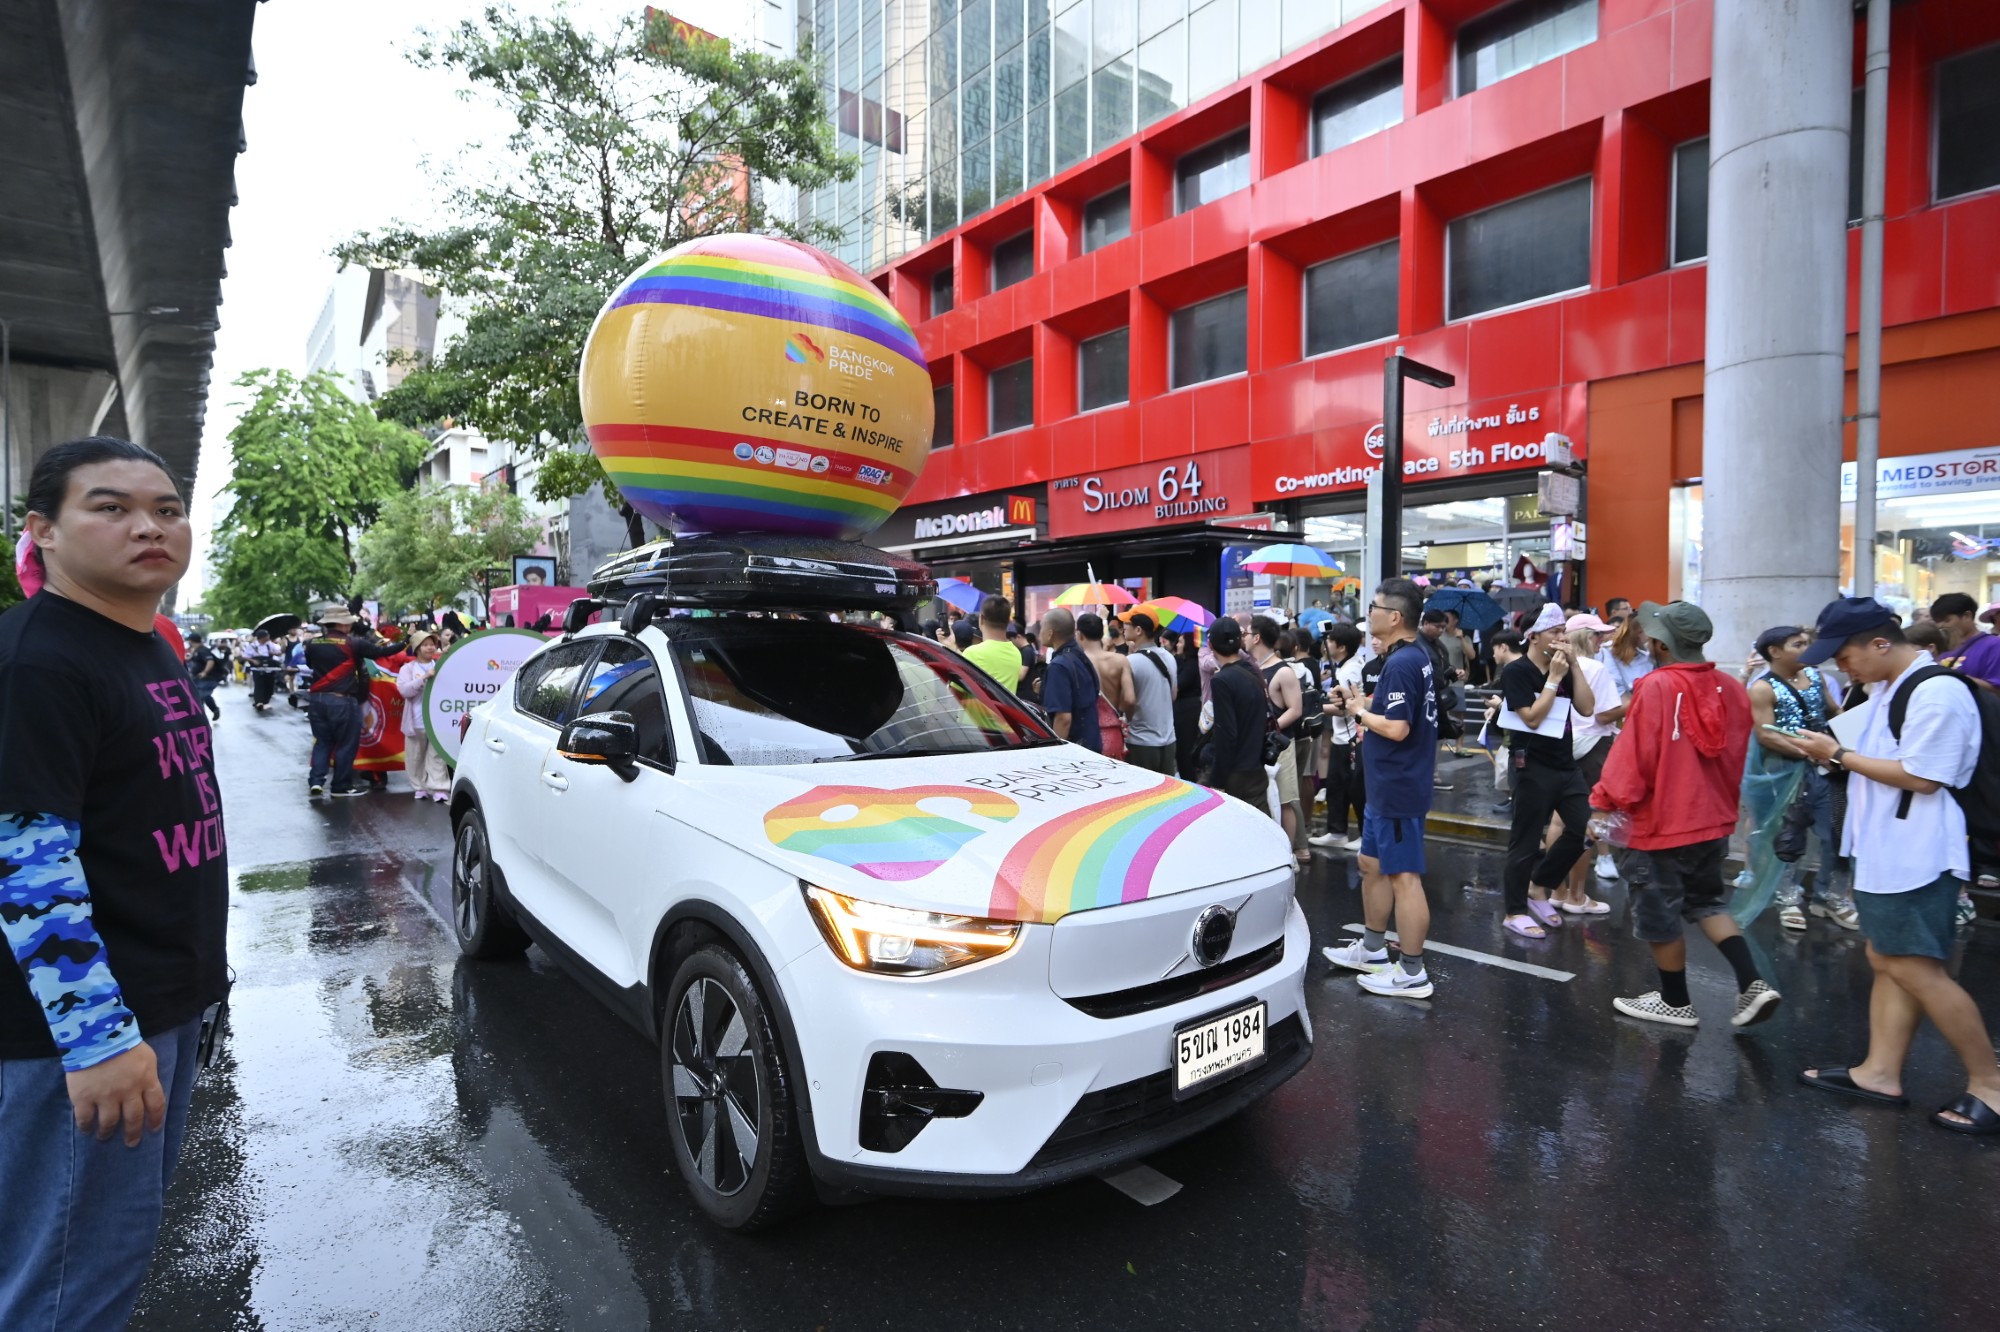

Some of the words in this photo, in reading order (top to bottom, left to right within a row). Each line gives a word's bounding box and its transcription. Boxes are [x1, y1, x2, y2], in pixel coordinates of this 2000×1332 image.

[829, 345, 895, 377] BANGKOK
[829, 359, 873, 381] PRIDE
[795, 390, 855, 417] BORN
[860, 404, 881, 423] TO
[1505, 404, 1526, 425] ชั้น
[1528, 407, 1539, 421] 5
[742, 406, 829, 435] CREATE
[832, 422, 846, 439] &
[851, 426, 904, 453] INSPIRE
[1367, 433, 1384, 449] S6
[859, 465, 882, 479] DRAG
[1158, 460, 1202, 501] 64
[1275, 466, 1374, 493] Co-working
[1449, 447, 1485, 469] 5th
[1935, 476, 1973, 487] saving
[1155, 496, 1227, 519] BUILDING
[145, 678, 203, 722] SEX
[1388, 691, 1406, 701] CIBC
[152, 725, 213, 780] WOR
[965, 758, 1127, 789] BANGKOK
[1009, 773, 1127, 802] PRIDE
[194, 772, 218, 815] IS
[152, 814, 224, 874] WO
[1224, 1010, 1260, 1047] 1984
